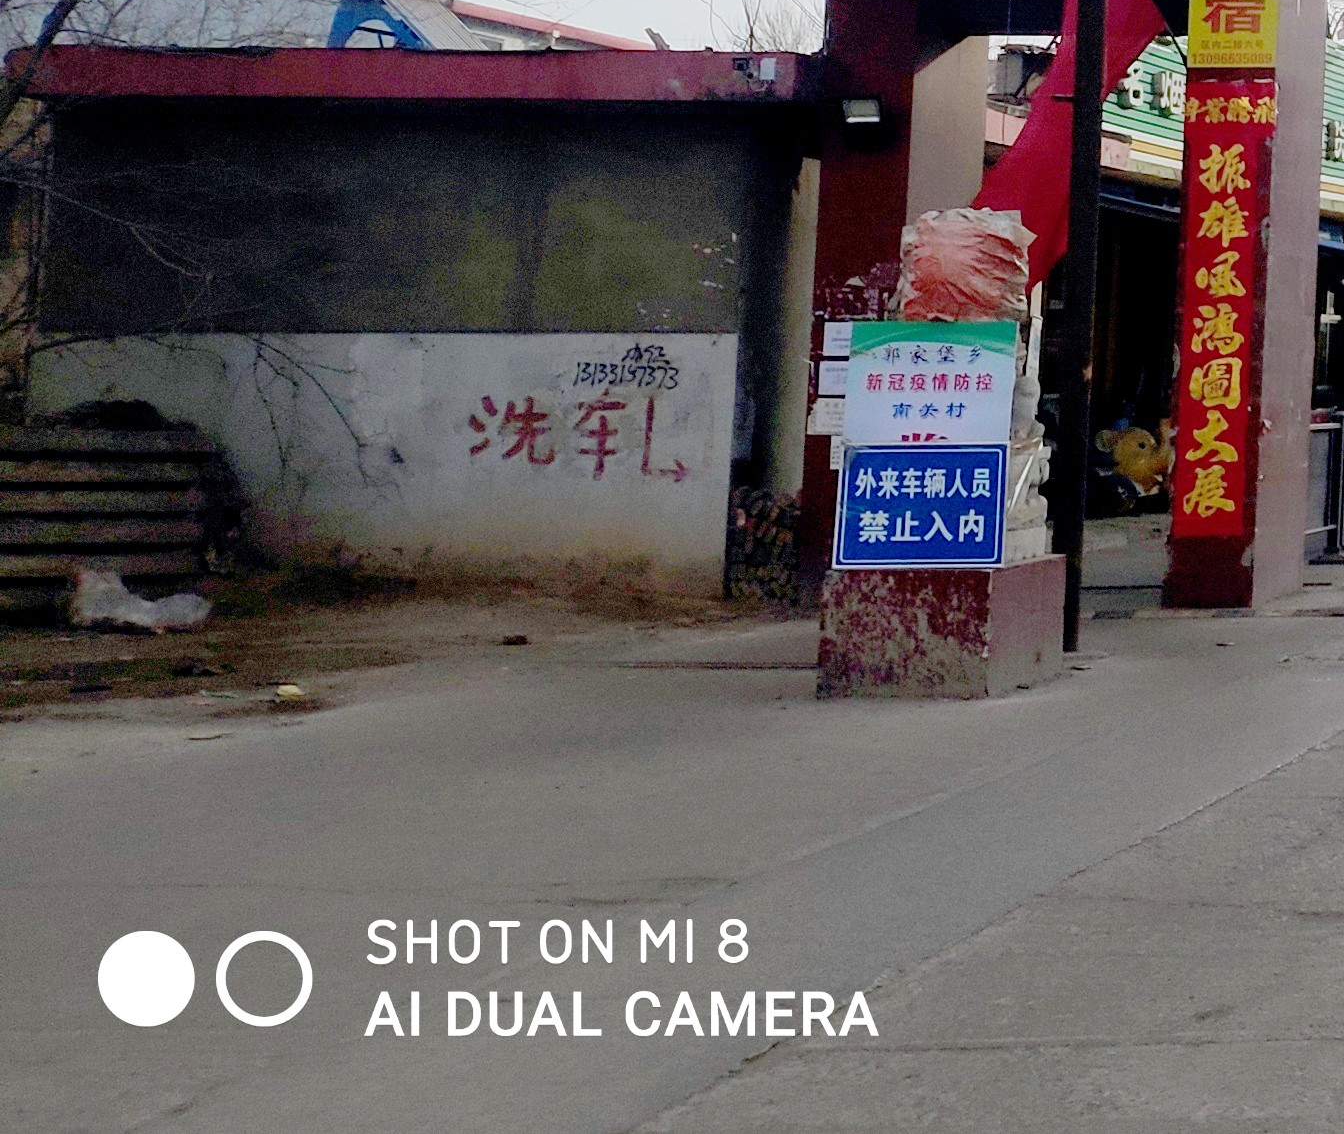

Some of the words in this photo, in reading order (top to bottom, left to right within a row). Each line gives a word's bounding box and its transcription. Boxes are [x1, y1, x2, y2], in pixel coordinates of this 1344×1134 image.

[882, 344, 983, 364] 郭家堡乡
[865, 372, 994, 391] 新冠疫情防控
[892, 402, 966, 418] 南关村
[468, 388, 627, 481] 洗车
[854, 467, 992, 499] 外来车辆人员
[858, 509, 985, 543] 禁止入内
